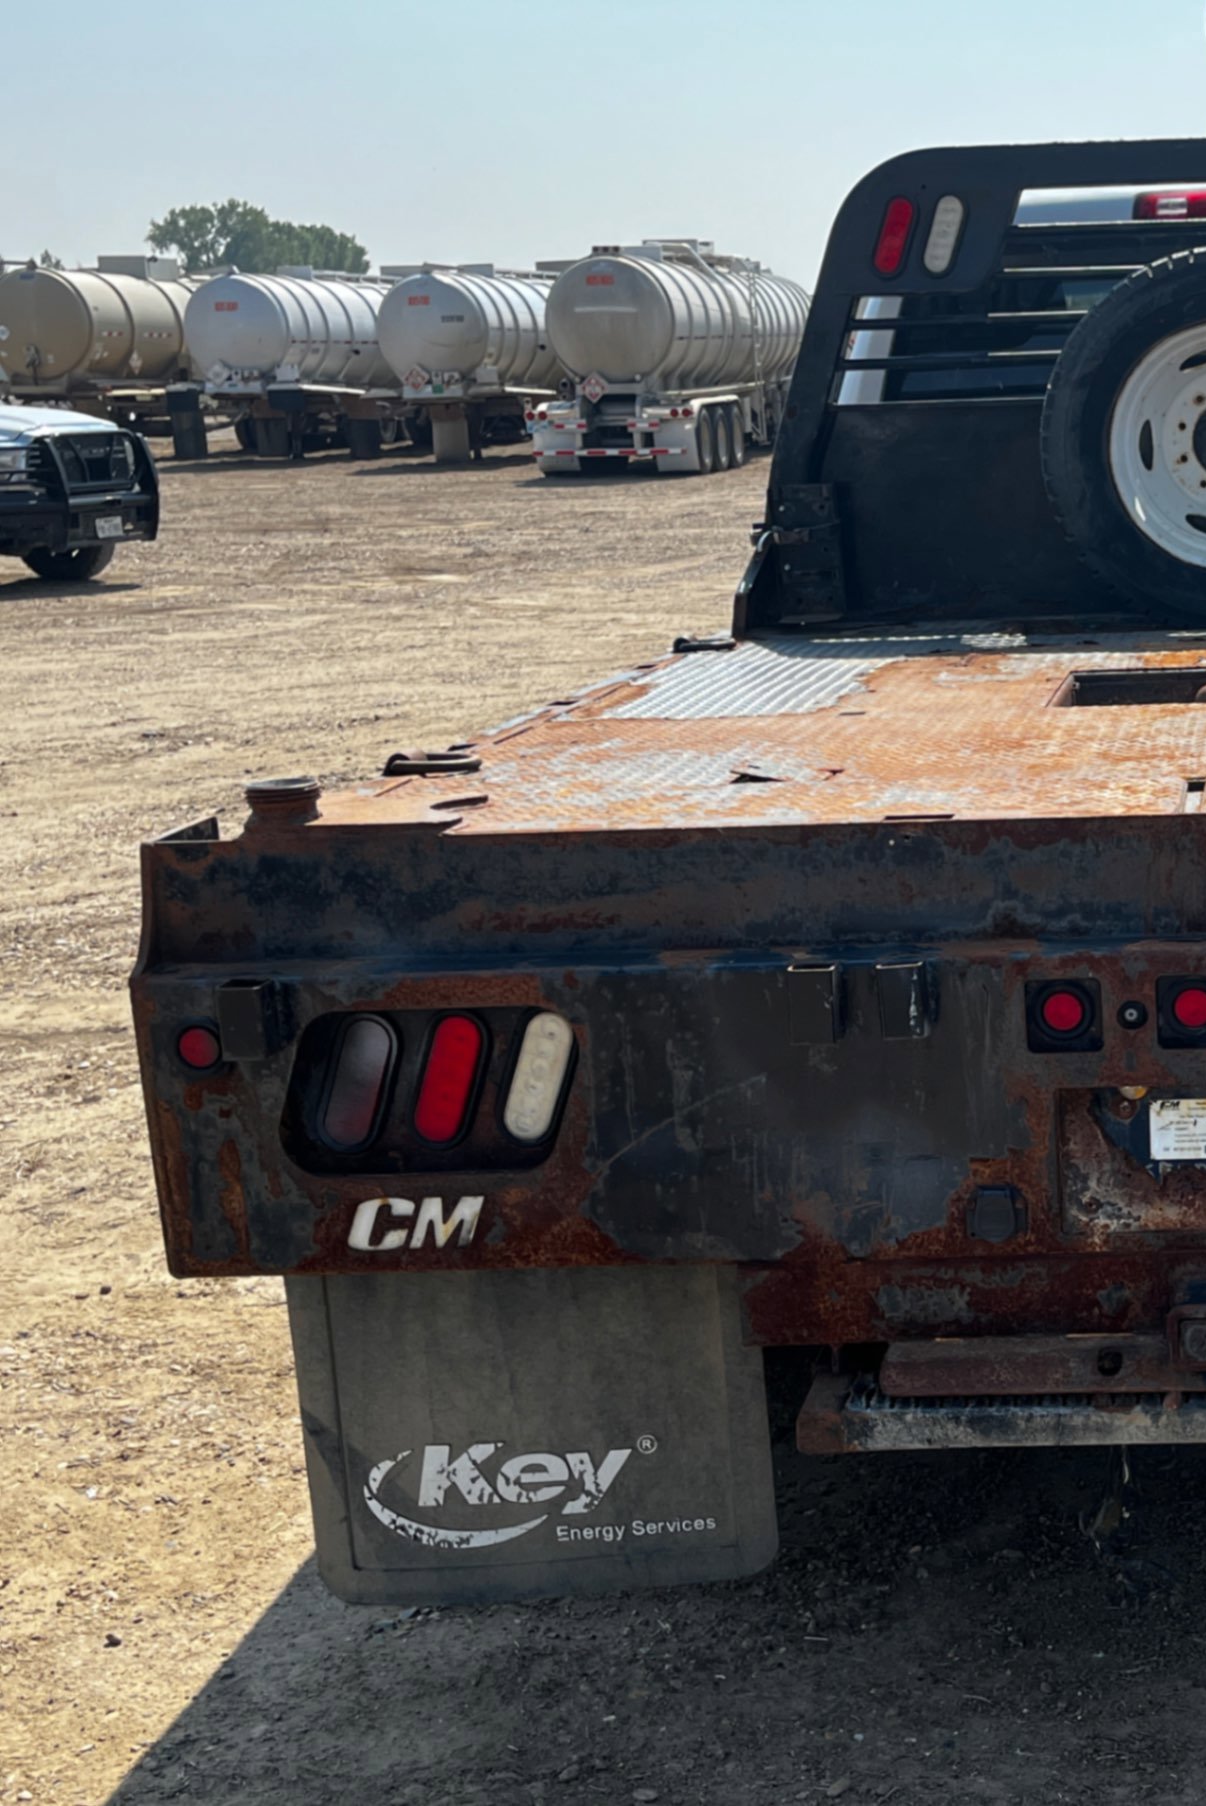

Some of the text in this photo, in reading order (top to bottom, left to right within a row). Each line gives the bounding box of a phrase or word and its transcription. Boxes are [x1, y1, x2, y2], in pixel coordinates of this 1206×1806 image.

[347, 1195, 485, 1251] CM
[418, 1441, 633, 1514] Key
[556, 1515, 717, 1543] Energy Services
